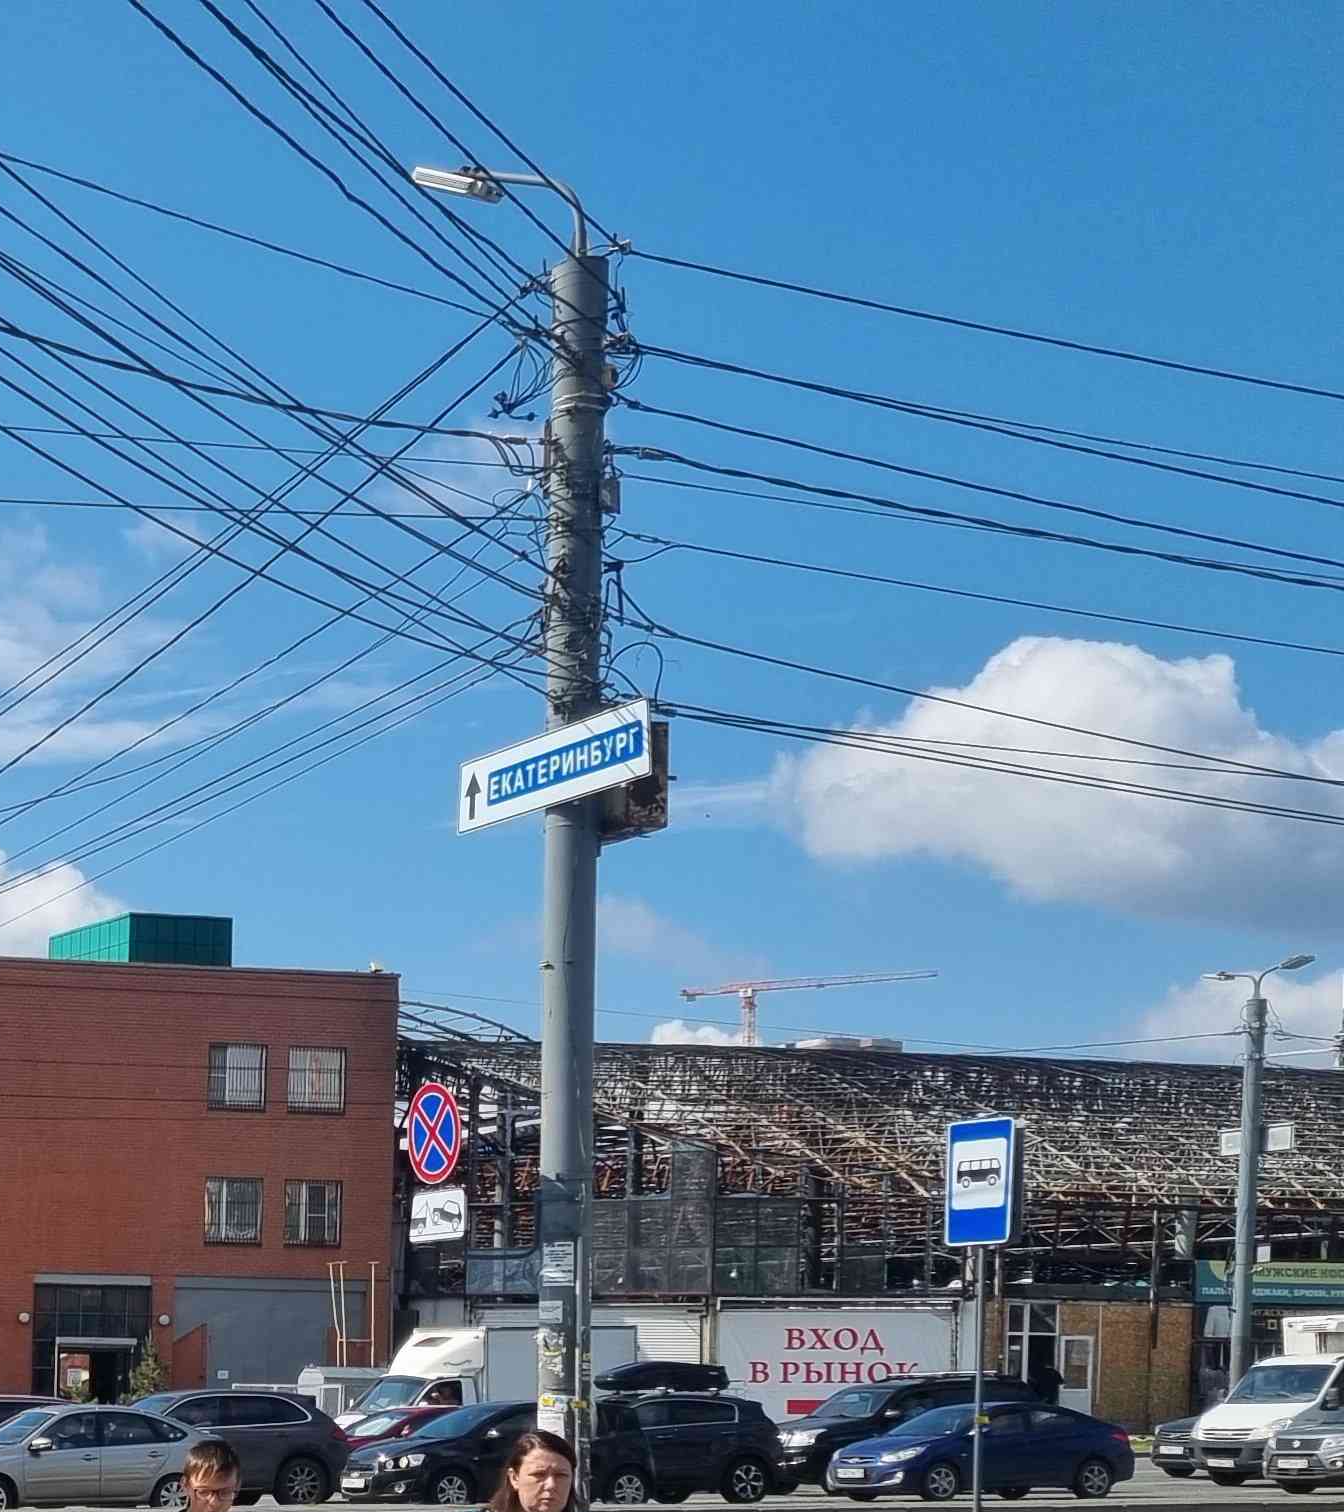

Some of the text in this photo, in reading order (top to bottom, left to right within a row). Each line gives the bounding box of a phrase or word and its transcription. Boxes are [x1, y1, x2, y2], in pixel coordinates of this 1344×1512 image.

[488, 726, 640, 801] ЕКАТЕРИНБУРГ
[783, 1327, 886, 1357] ВХОД
[748, 1361, 771, 1384] В
